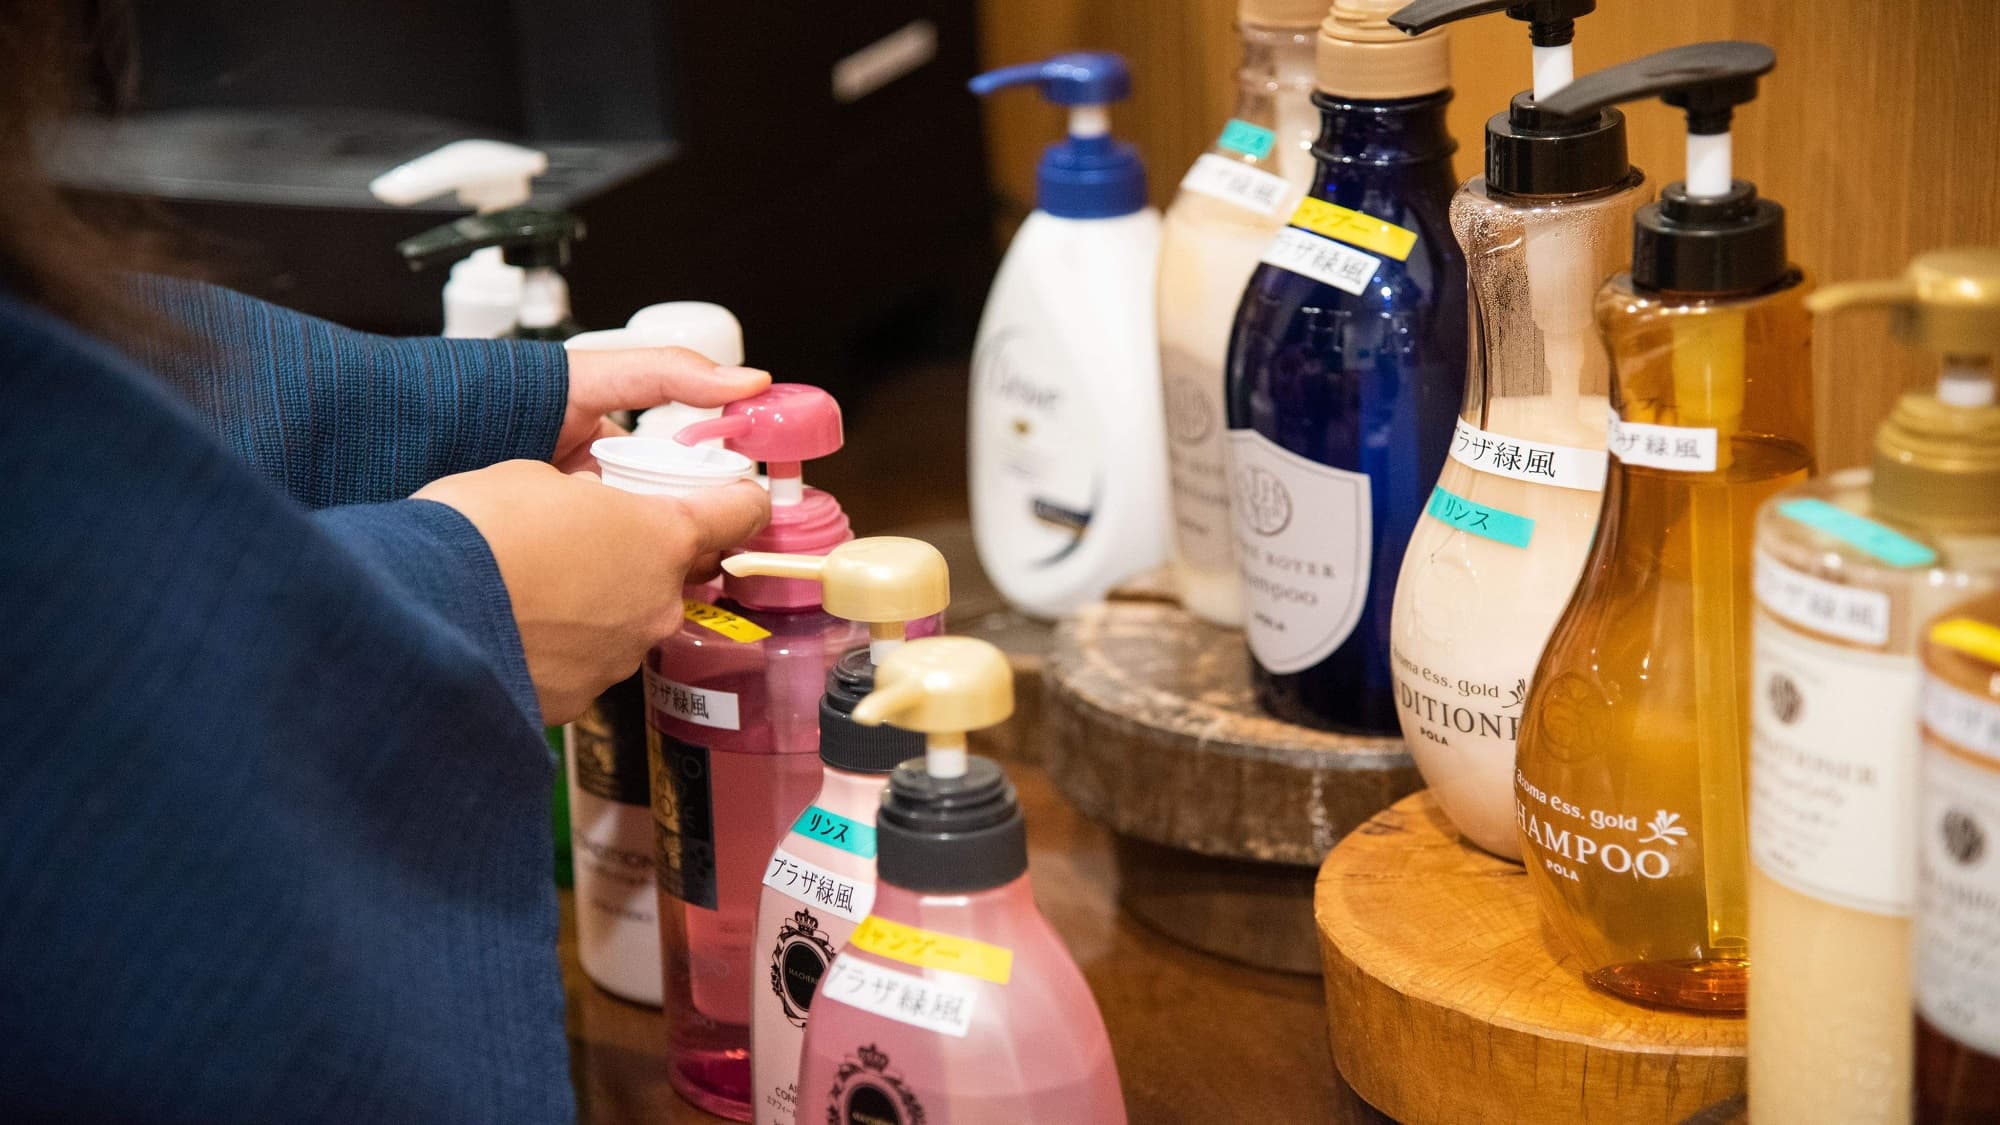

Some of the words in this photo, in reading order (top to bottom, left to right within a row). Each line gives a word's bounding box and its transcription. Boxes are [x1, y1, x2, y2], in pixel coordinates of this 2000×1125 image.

[1456, 425, 1556, 478] ラザ緑風
[1446, 498, 1488, 530] リンス
[1422, 667, 1453, 689] ess.
[1458, 679, 1499, 698] gold
[809, 813, 849, 843] リンス
[1550, 795, 1586, 820] ess.
[1590, 809, 1638, 832] gold
[1516, 797, 1670, 879] HAMPOO
[771, 857, 854, 913] プラザ緑風
[1545, 858, 1580, 882] POLA
